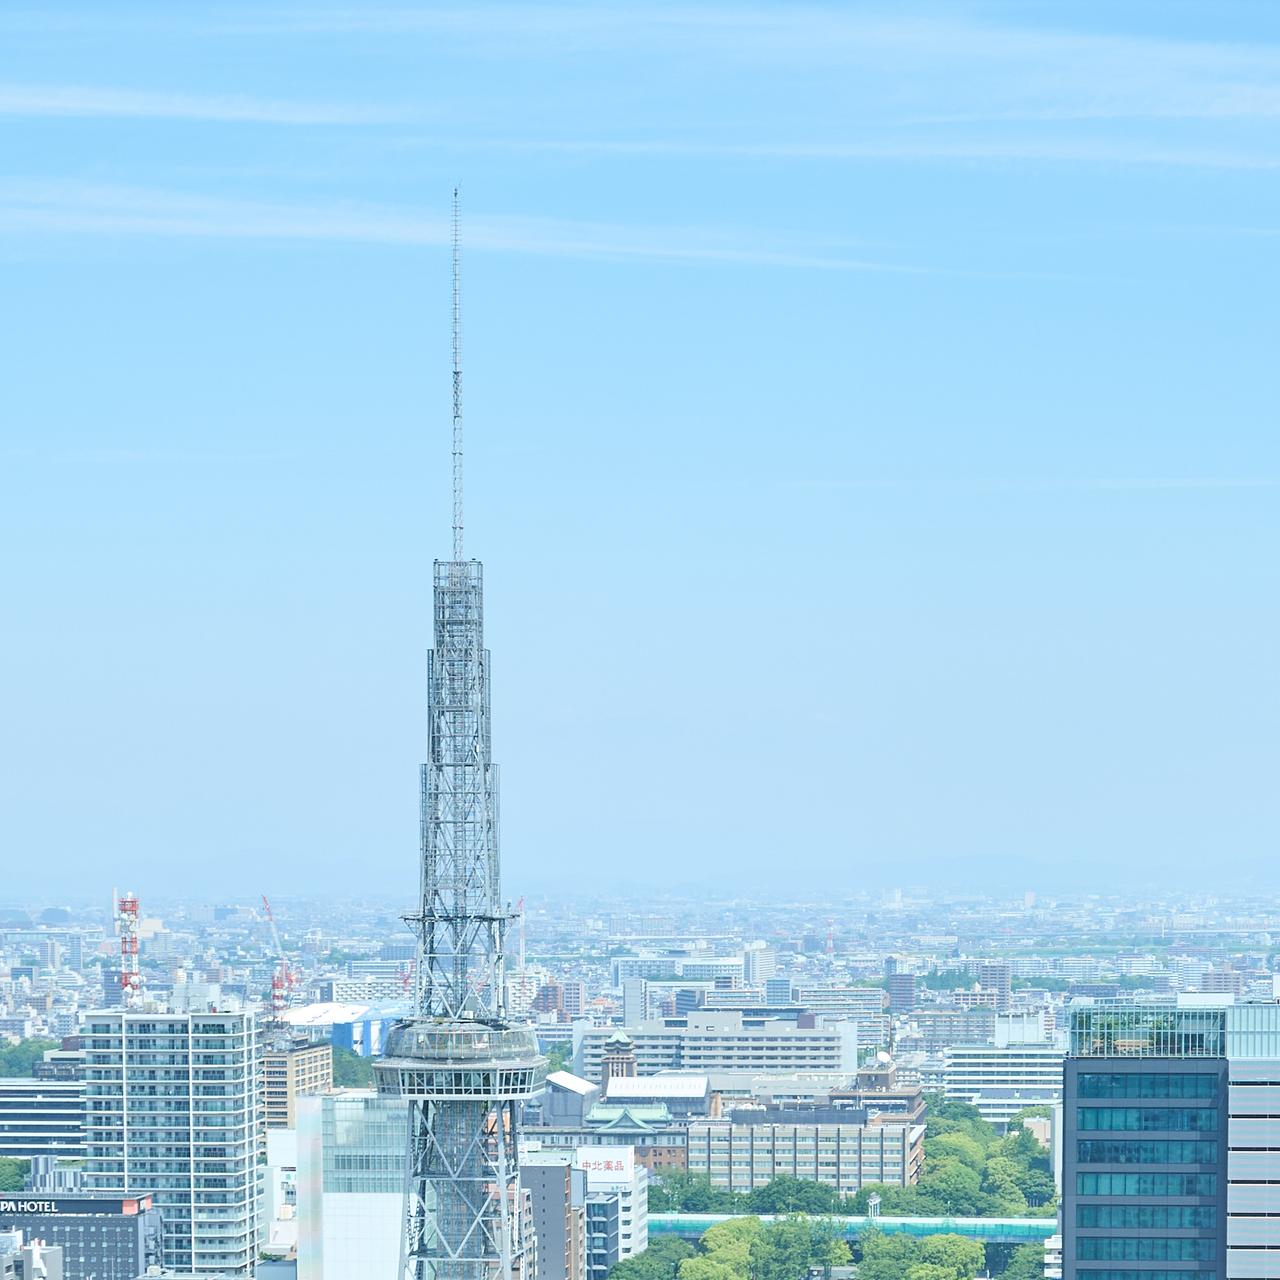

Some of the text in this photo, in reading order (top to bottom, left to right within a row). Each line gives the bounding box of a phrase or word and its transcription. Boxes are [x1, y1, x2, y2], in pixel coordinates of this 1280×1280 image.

[582, 1160, 624, 1171] 中北薬品
[18, 1202, 58, 1213] HOTEL
